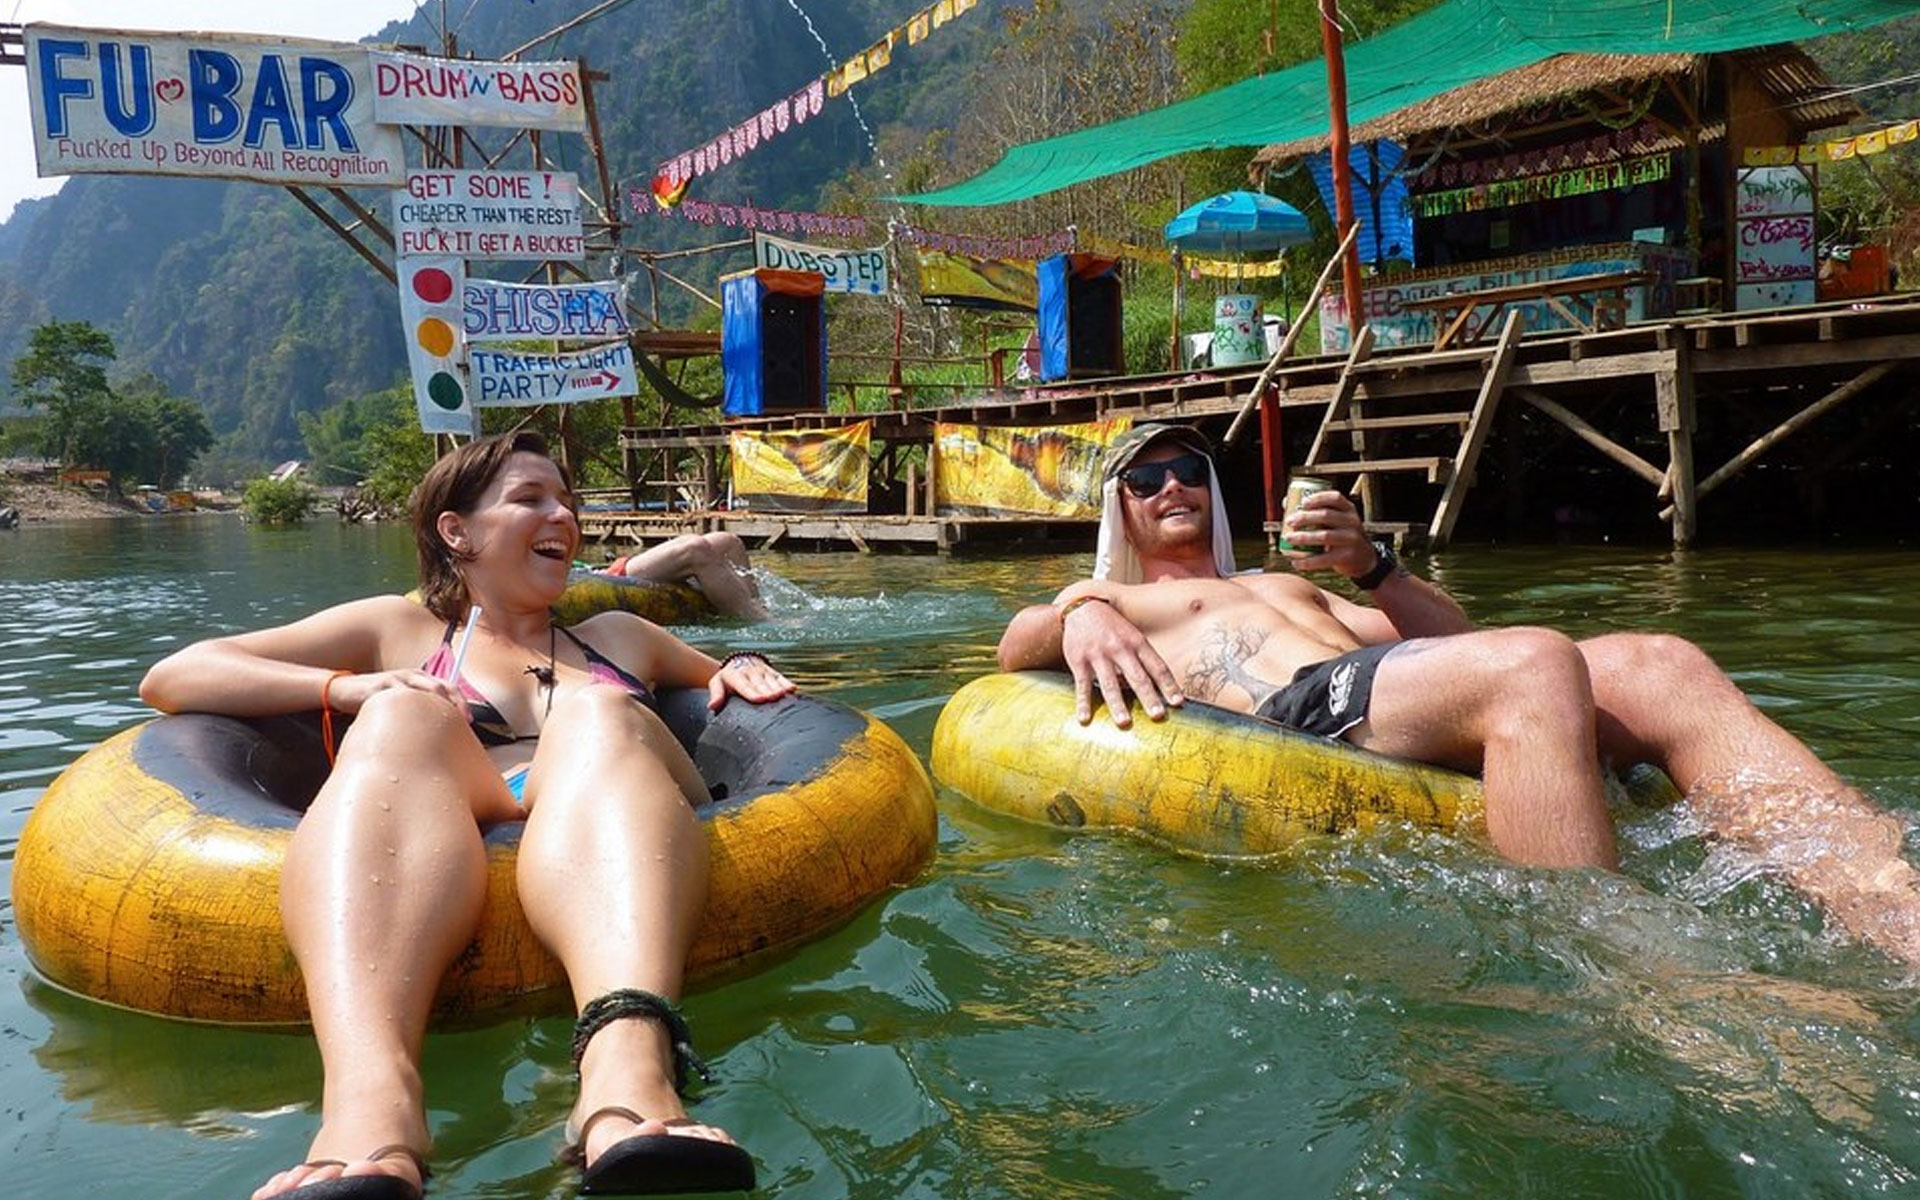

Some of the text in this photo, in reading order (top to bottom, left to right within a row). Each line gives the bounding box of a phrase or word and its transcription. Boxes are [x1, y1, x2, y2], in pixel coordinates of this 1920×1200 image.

[38, 38, 359, 153] FU BAR
[141, 140, 167, 167] Up
[174, 142, 245, 168] Beyond
[252, 151, 275, 171] All
[282, 151, 390, 178] Recognition
[408, 175, 455, 198] GET
[468, 175, 532, 199] SOME
[400, 204, 466, 224] CHEAPER
[472, 207, 507, 223] THAN
[508, 208, 535, 225] THE
[402, 231, 583, 253] FUCK IT GET A BUCKET
[765, 241, 883, 279] DUBSTEP
[464, 286, 629, 335] SHISHA
[472, 346, 628, 373] TRAFFIC LIGHT
[481, 374, 567, 400] PARTY
